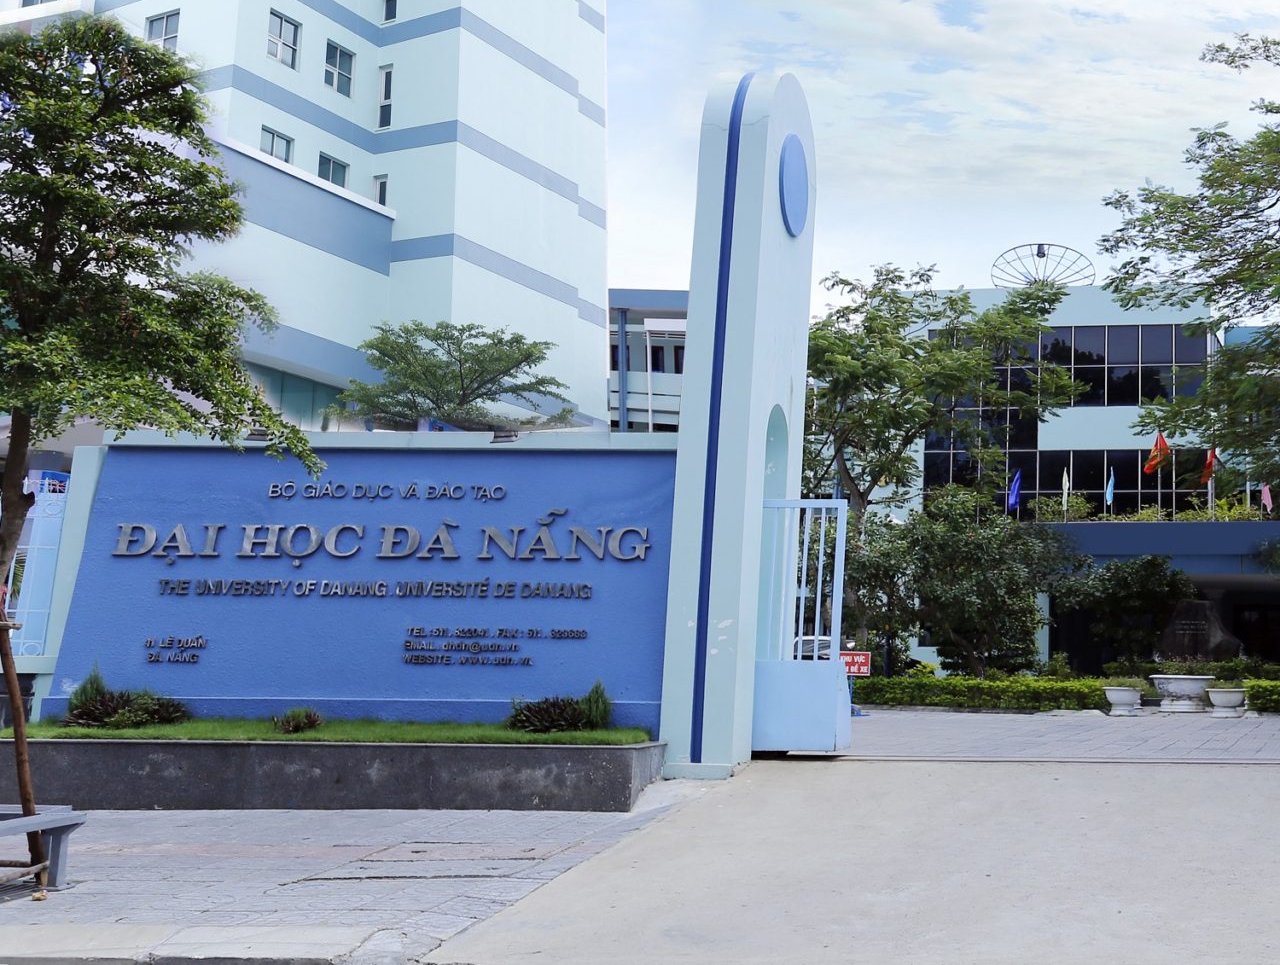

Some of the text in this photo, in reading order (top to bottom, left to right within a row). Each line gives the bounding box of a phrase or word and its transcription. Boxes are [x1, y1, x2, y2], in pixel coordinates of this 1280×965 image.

[268, 480, 507, 503] BỘ GIÁO DỤC VÀ ĐÀO TẠO
[112, 507, 651, 567] ĐẠI HỌC ĐÀ NẴNG
[159, 578, 191, 595] THE
[196, 578, 290, 596] UNIVERSITY
[293, 579, 316, 596] OF
[395, 577, 491, 598] UNIVERSITÉ
[492, 582, 517, 598] DE
[520, 583, 593, 599] DANANG
